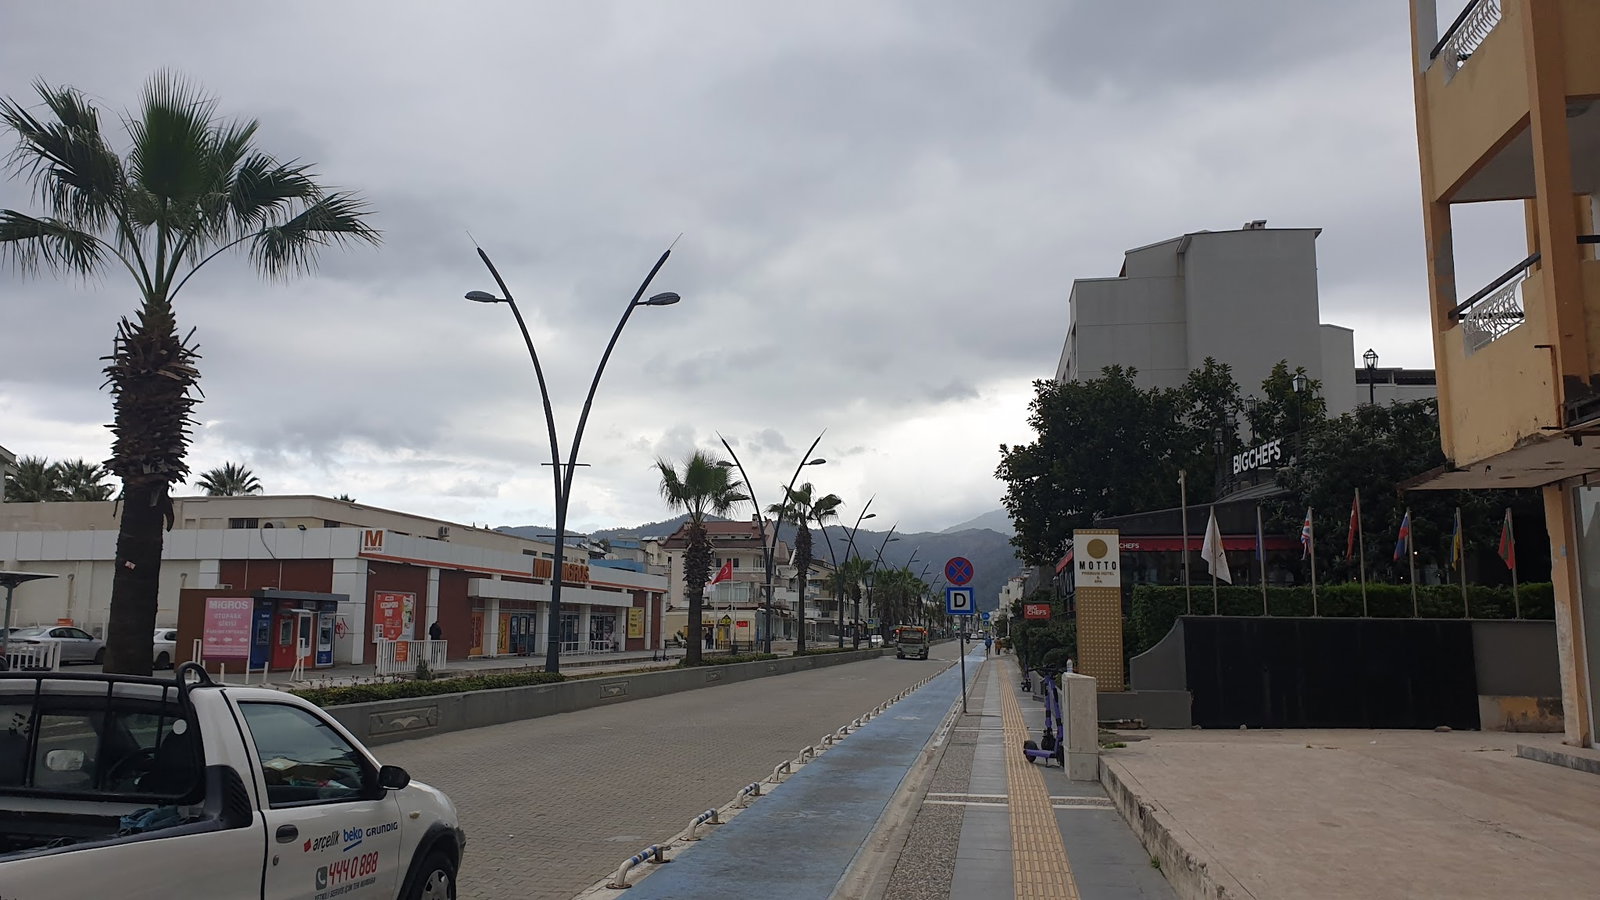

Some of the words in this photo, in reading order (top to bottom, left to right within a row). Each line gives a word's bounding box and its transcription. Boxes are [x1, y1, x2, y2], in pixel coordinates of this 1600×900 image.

[1233, 438, 1281, 475] BIGCHEFS
[365, 530, 383, 546] M
[1079, 561, 1117, 570] MOTTO
[954, 592, 966, 607] D
[313, 829, 340, 852] arçelik
[343, 826, 363, 842] beko
[366, 822, 398, 837] GRUNDIG
[359, 851, 379, 877] 888
